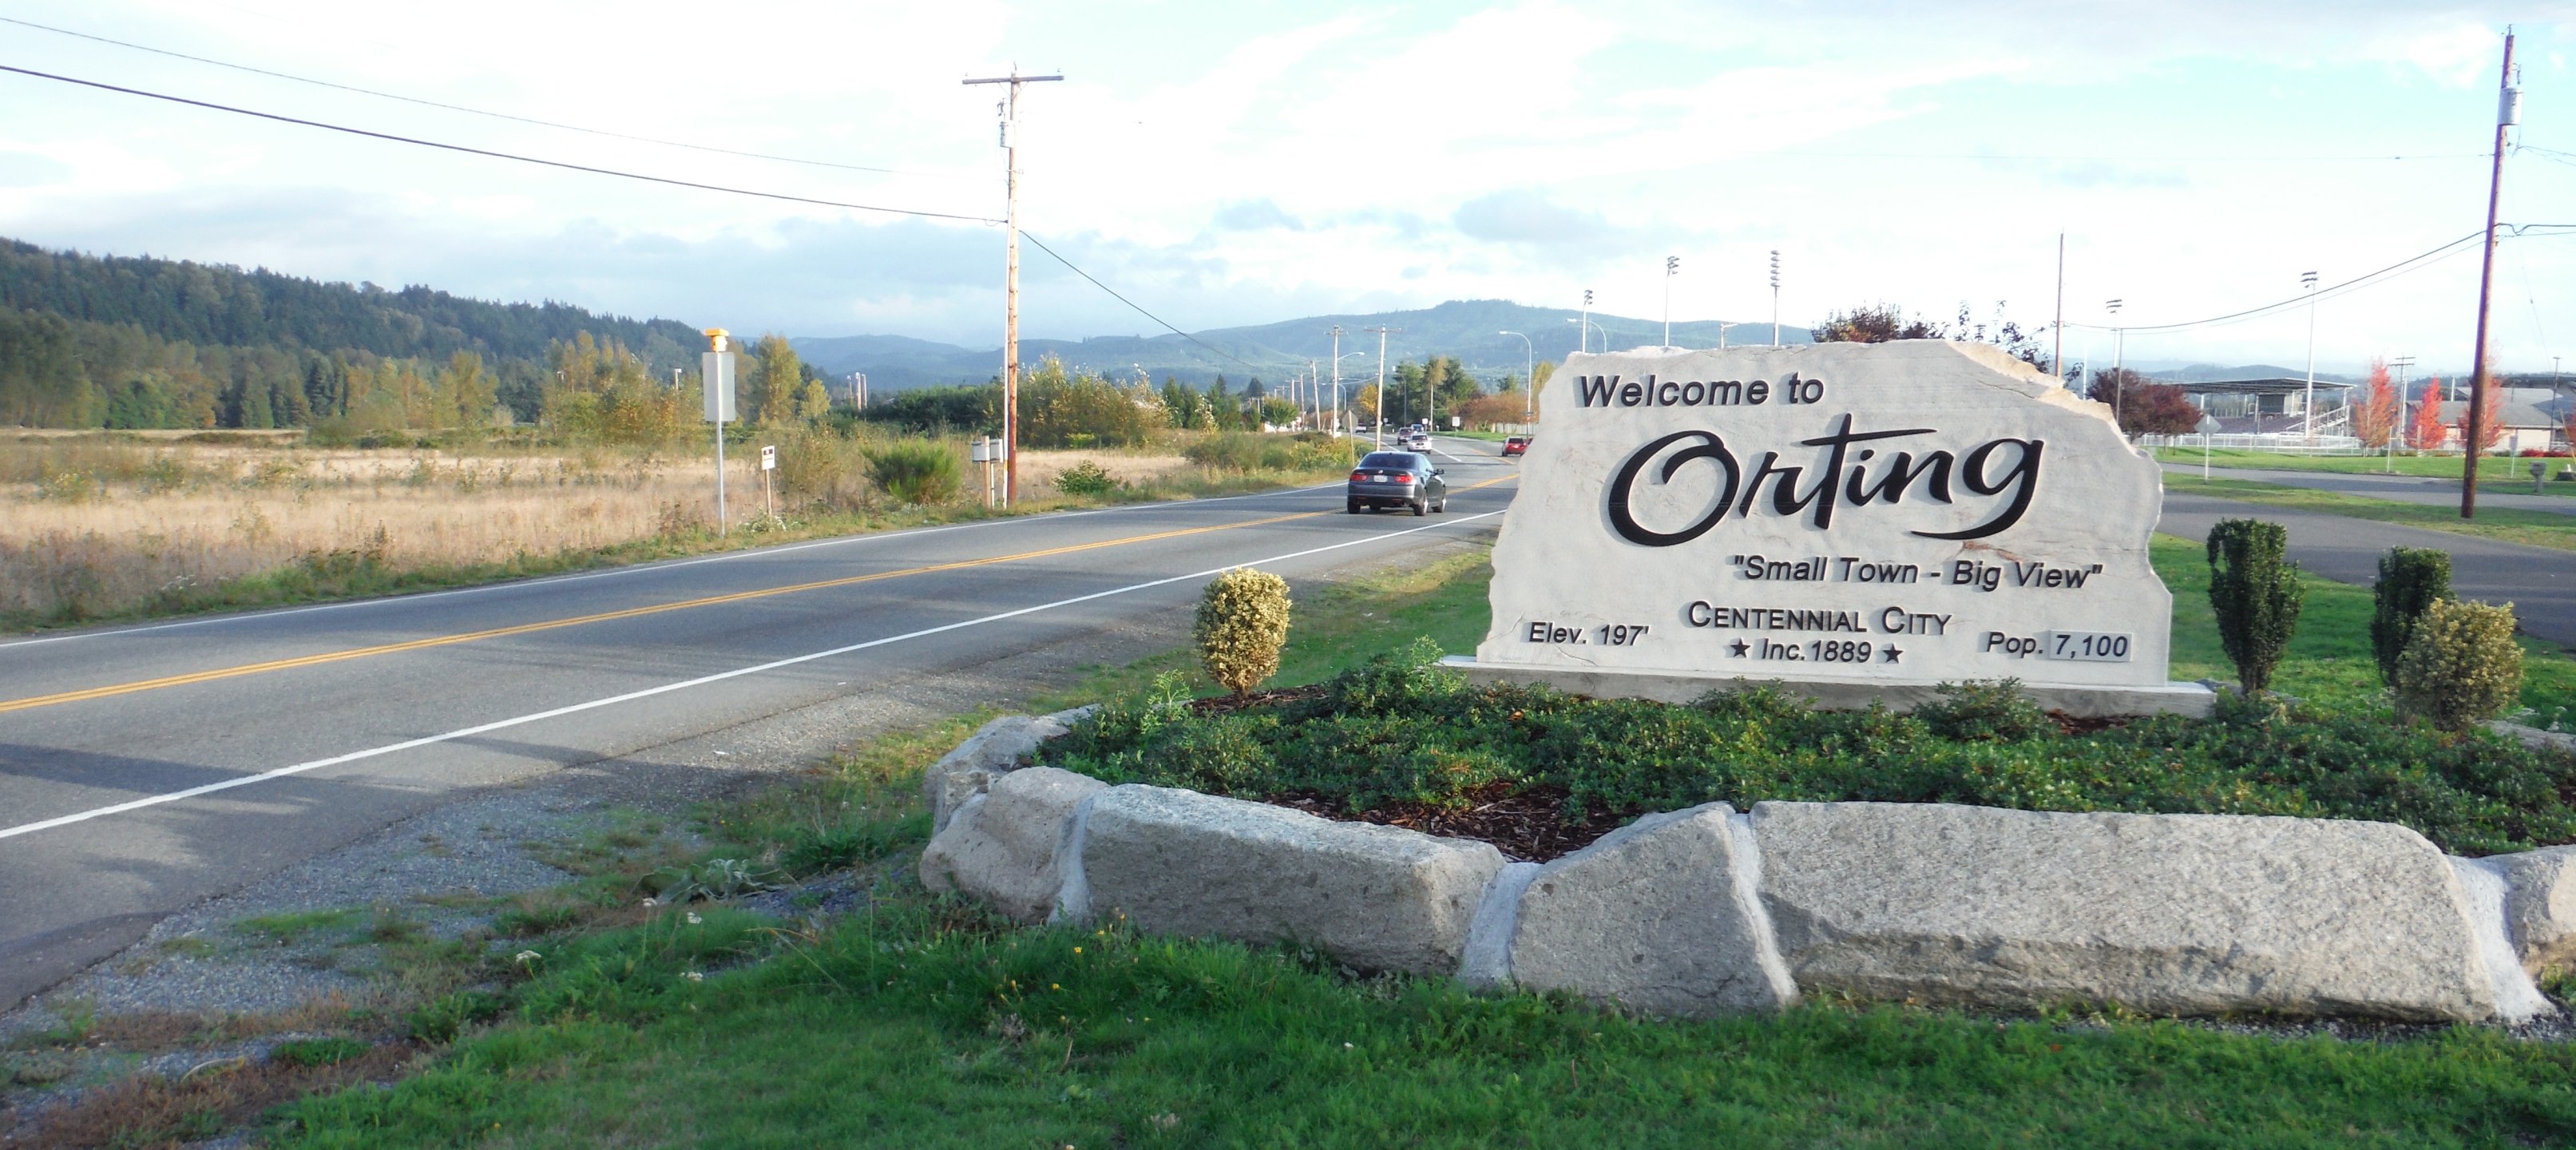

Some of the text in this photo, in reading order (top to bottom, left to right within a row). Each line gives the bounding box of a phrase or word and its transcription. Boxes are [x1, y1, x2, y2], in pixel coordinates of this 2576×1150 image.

[1581, 372, 1825, 407] Welcome to
[1607, 413, 2044, 547] Orting
[1734, 555, 1829, 581] "Small
[1840, 557, 1919, 584] Town
[1953, 560, 2001, 593] Big
[2015, 561, 2103, 589] View"
[1529, 621, 1649, 646] Elev. 197'
[1688, 601, 1952, 635] CENTENNIAL CITY
[1987, 632, 2129, 659] Pop. 7,100
